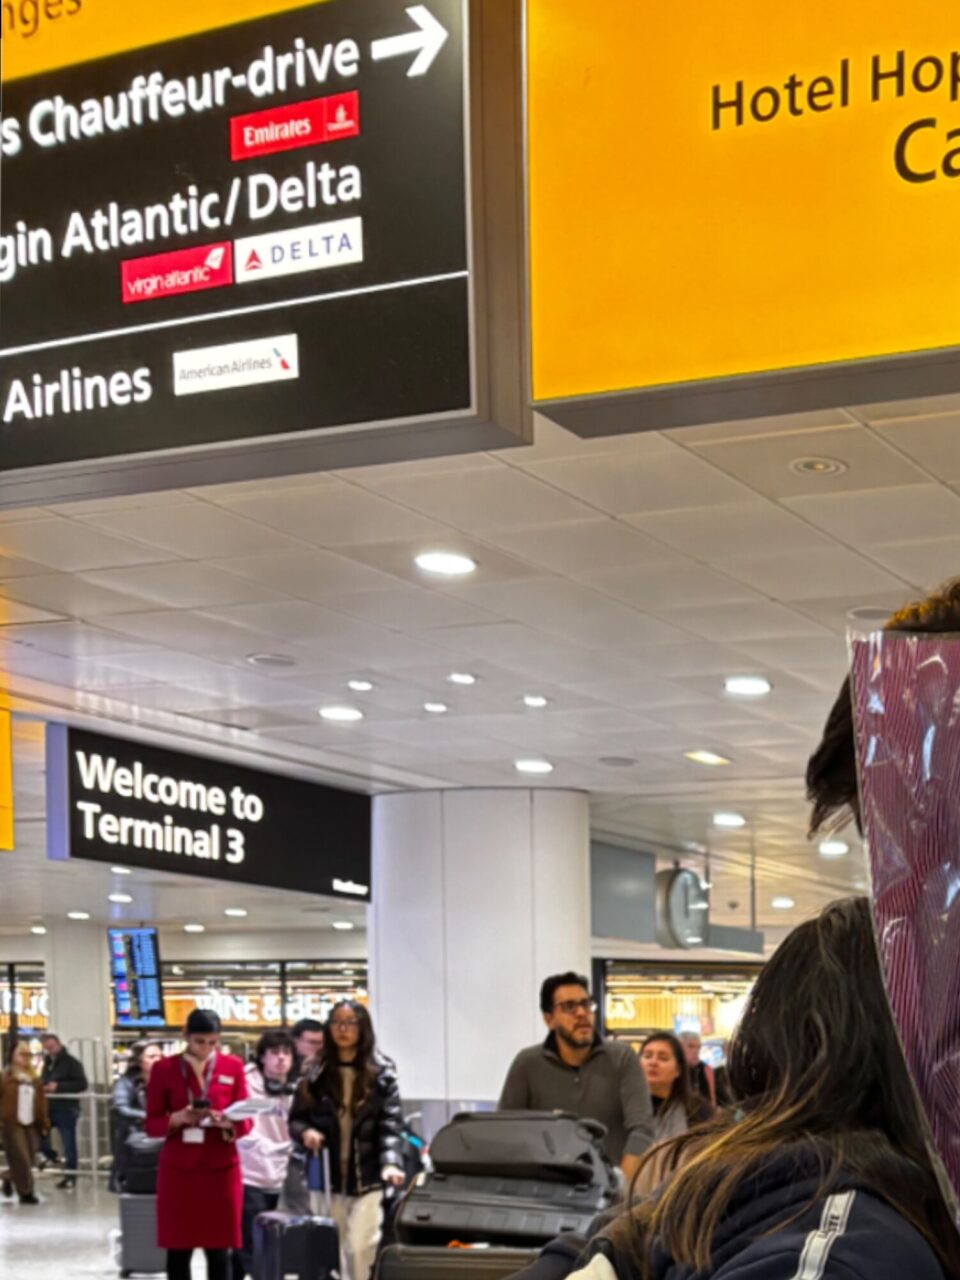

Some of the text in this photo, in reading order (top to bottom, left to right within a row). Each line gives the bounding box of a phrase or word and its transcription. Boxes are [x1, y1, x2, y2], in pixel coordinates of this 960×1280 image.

[27, 36, 361, 148] Chauffeur-drive
[711, 58, 851, 131] Hotel
[242, 117, 312, 148] Emirates
[270, 232, 353, 265] DELTA
[2, 366, 153, 423] Airlines
[75, 750, 264, 822] Welcome to
[76, 799, 246, 864] Terminal 3
